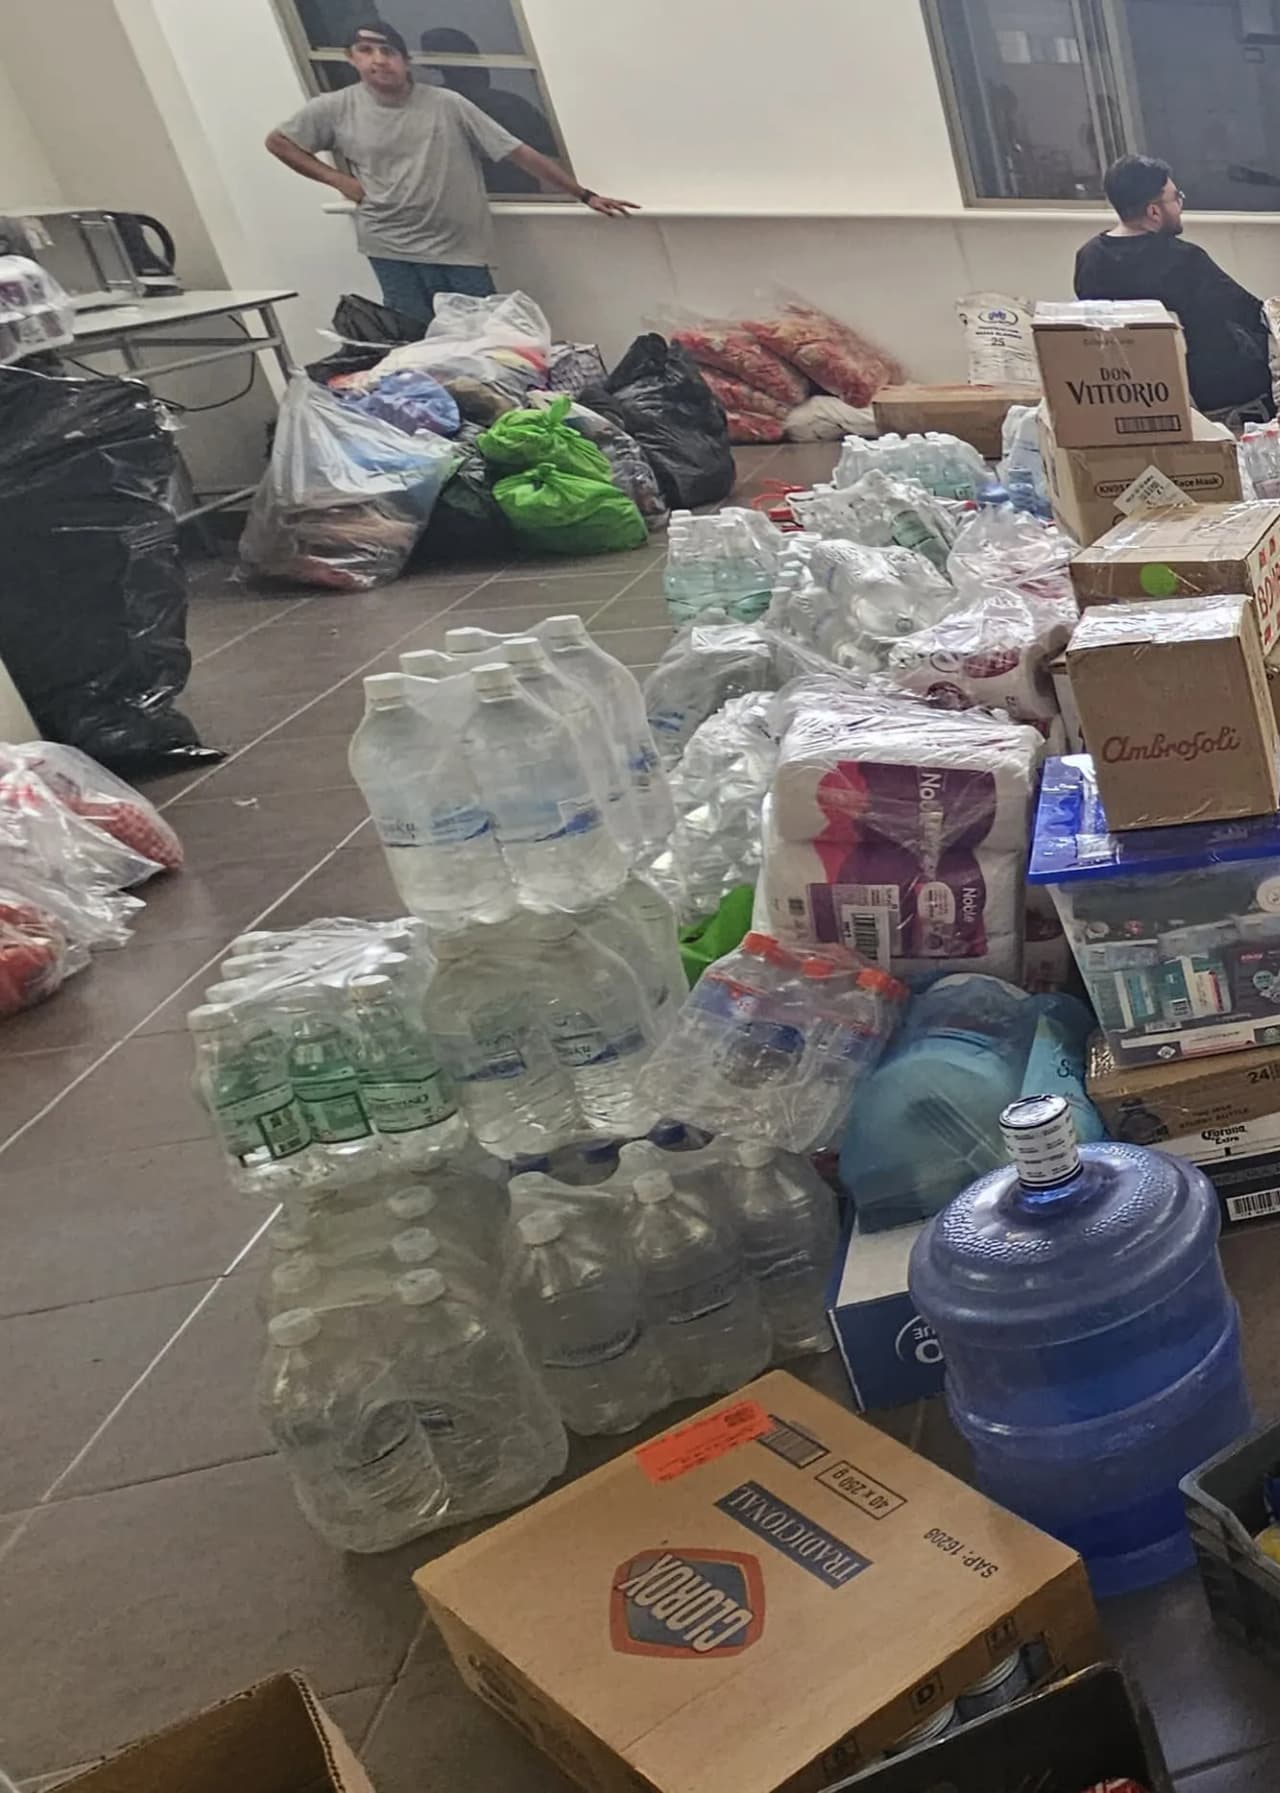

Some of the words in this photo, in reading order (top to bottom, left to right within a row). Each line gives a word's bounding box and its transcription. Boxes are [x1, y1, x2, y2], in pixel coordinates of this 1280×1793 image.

[1101, 367, 1132, 382] DON
[1066, 381, 1169, 406] VITTORIO
[1102, 726, 1241, 763] Ambrosoli
[1247, 1066, 1269, 1084] 24
[1201, 1124, 1248, 1141] Corona
[1214, 1134, 1240, 1145] Extra
[867, 1492, 891, 1516] 40
[724, 1486, 862, 1581] TRADICIONAL
[963, 1554, 1000, 1581] SAP:
[616, 1551, 754, 1653] CLOROX
